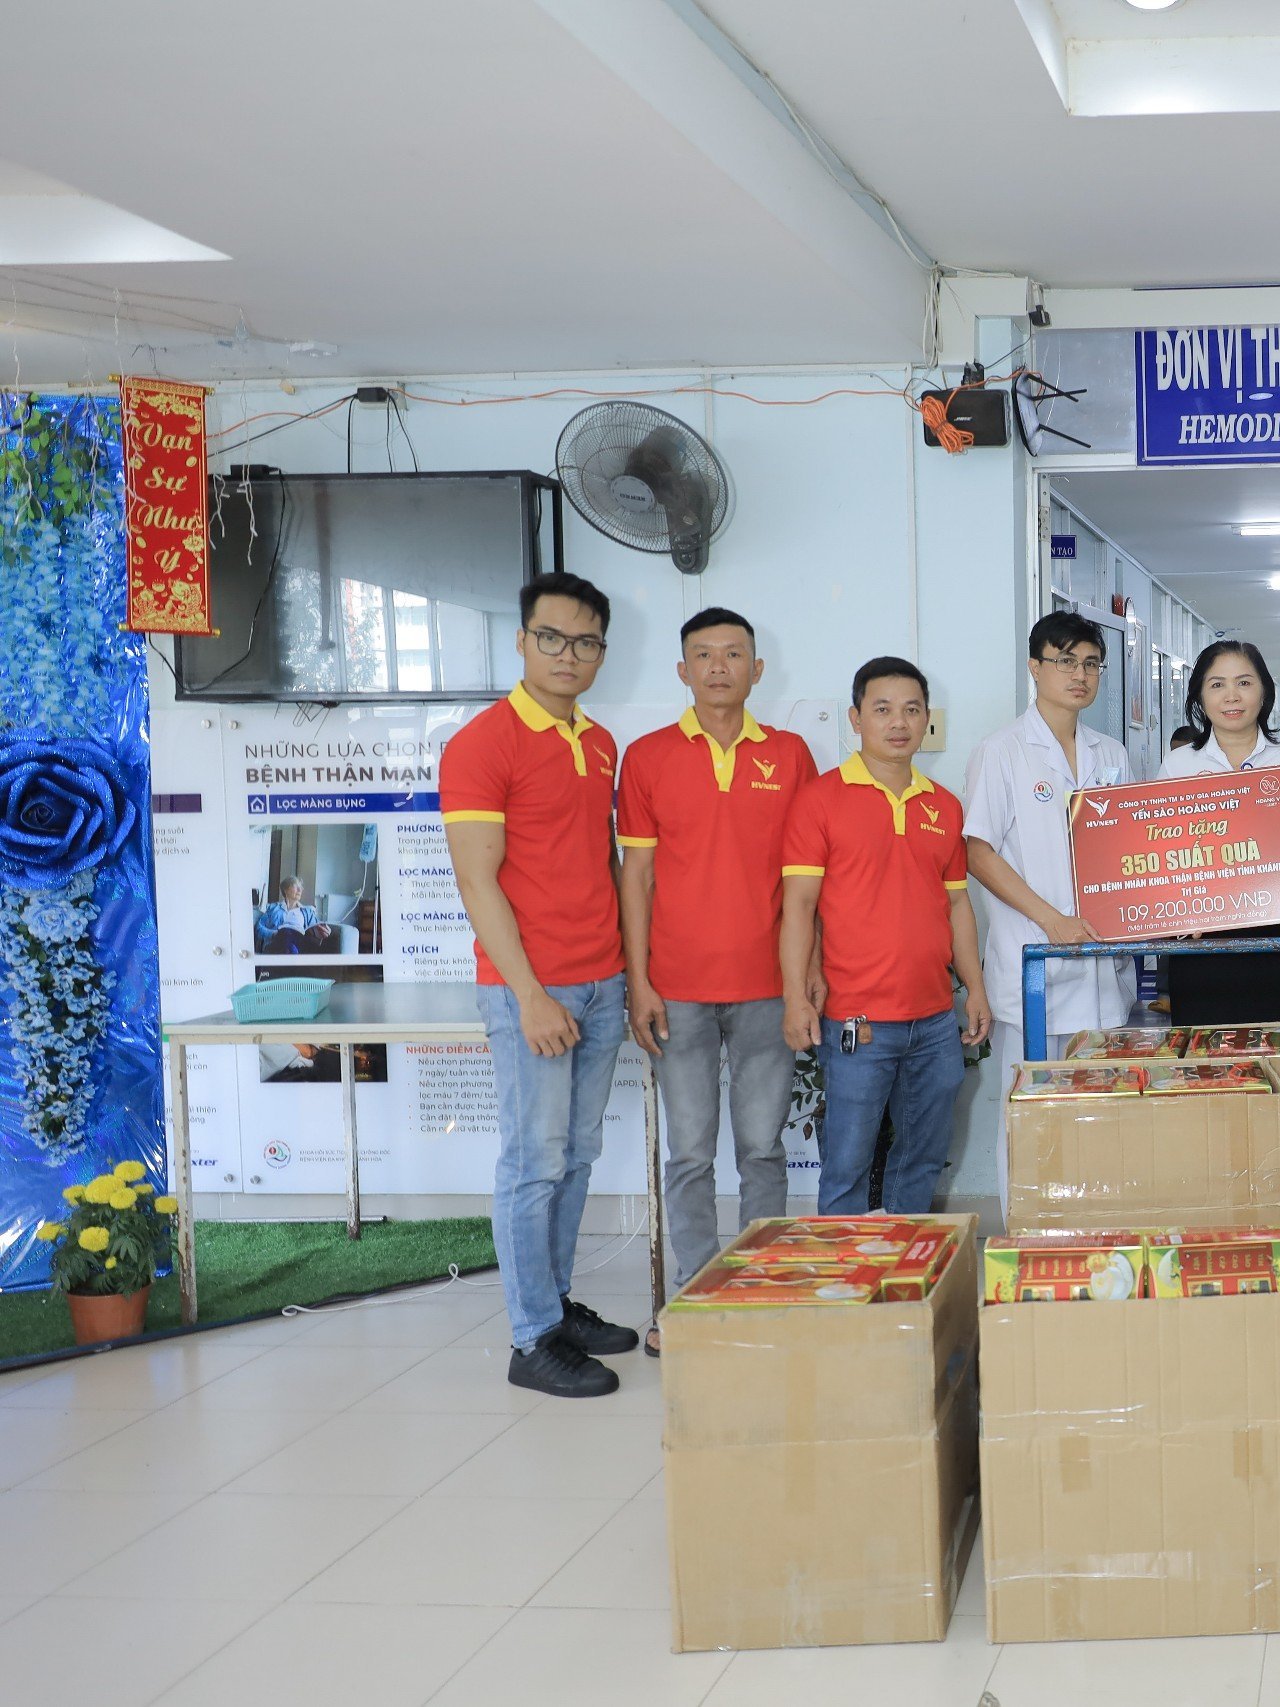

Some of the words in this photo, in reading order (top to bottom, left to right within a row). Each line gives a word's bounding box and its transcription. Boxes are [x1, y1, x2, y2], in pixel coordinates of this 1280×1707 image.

[1217, 328, 1243, 404] VỊ
[137, 422, 193, 454] Vạn
[144, 467, 187, 495] Sự
[245, 740, 319, 759] NHỮNG
[327, 741, 365, 761] LỰA
[372, 741, 431, 760] CHỌN
[246, 764, 306, 788] BỆNH
[312, 763, 374, 787] THẬN
[381, 766, 431, 786] MẠN
[276, 799, 298, 811] LỌC
[300, 797, 333, 808] MÀNG
[335, 799, 366, 811] BỤNG
[1118, 800, 1139, 809] CÔNG
[1149, 797, 1168, 805] TNHH
[1210, 789, 1236, 797] HOÀNG
[1237, 786, 1251, 795] VIỆT
[1131, 807, 1151, 821] YẾN
[1153, 806, 1174, 817] SÀO
[1178, 802, 1217, 816] HOÀNG
[1219, 798, 1240, 812] VIỆT
[397, 824, 443, 833] PHƯƠNG
[1086, 819, 1118, 828] HVNEST
[1146, 823, 1183, 841] Trao
[1188, 819, 1228, 838] tặng
[1121, 852, 1160, 876] 350
[1165, 841, 1215, 871] SUẤT
[1220, 837, 1261, 866] QUÀ
[399, 868, 419, 878] LỌC
[422, 867, 453, 876] MÀNG
[1083, 884, 1099, 894] CHO
[1101, 881, 1123, 893] BỆNH
[1125, 877, 1147, 889] NHÂN
[1148, 876, 1170, 887] KHOA
[1171, 872, 1192, 885] THẬN
[1193, 870, 1216, 883] BỆNH
[1217, 867, 1236, 879] VIỆN
[1181, 887, 1192, 897] Trị
[1193, 885, 1207, 895] Giá
[400, 913, 421, 923] LỌC
[423, 910, 455, 920] MÀNG
[1118, 895, 1225, 923] 109.200.000
[1229, 890, 1272, 910] VNĐ
[402, 944, 419, 956] LỢI
[422, 944, 439, 954] ÍCH
[406, 1045, 444, 1054] NHỮNG
